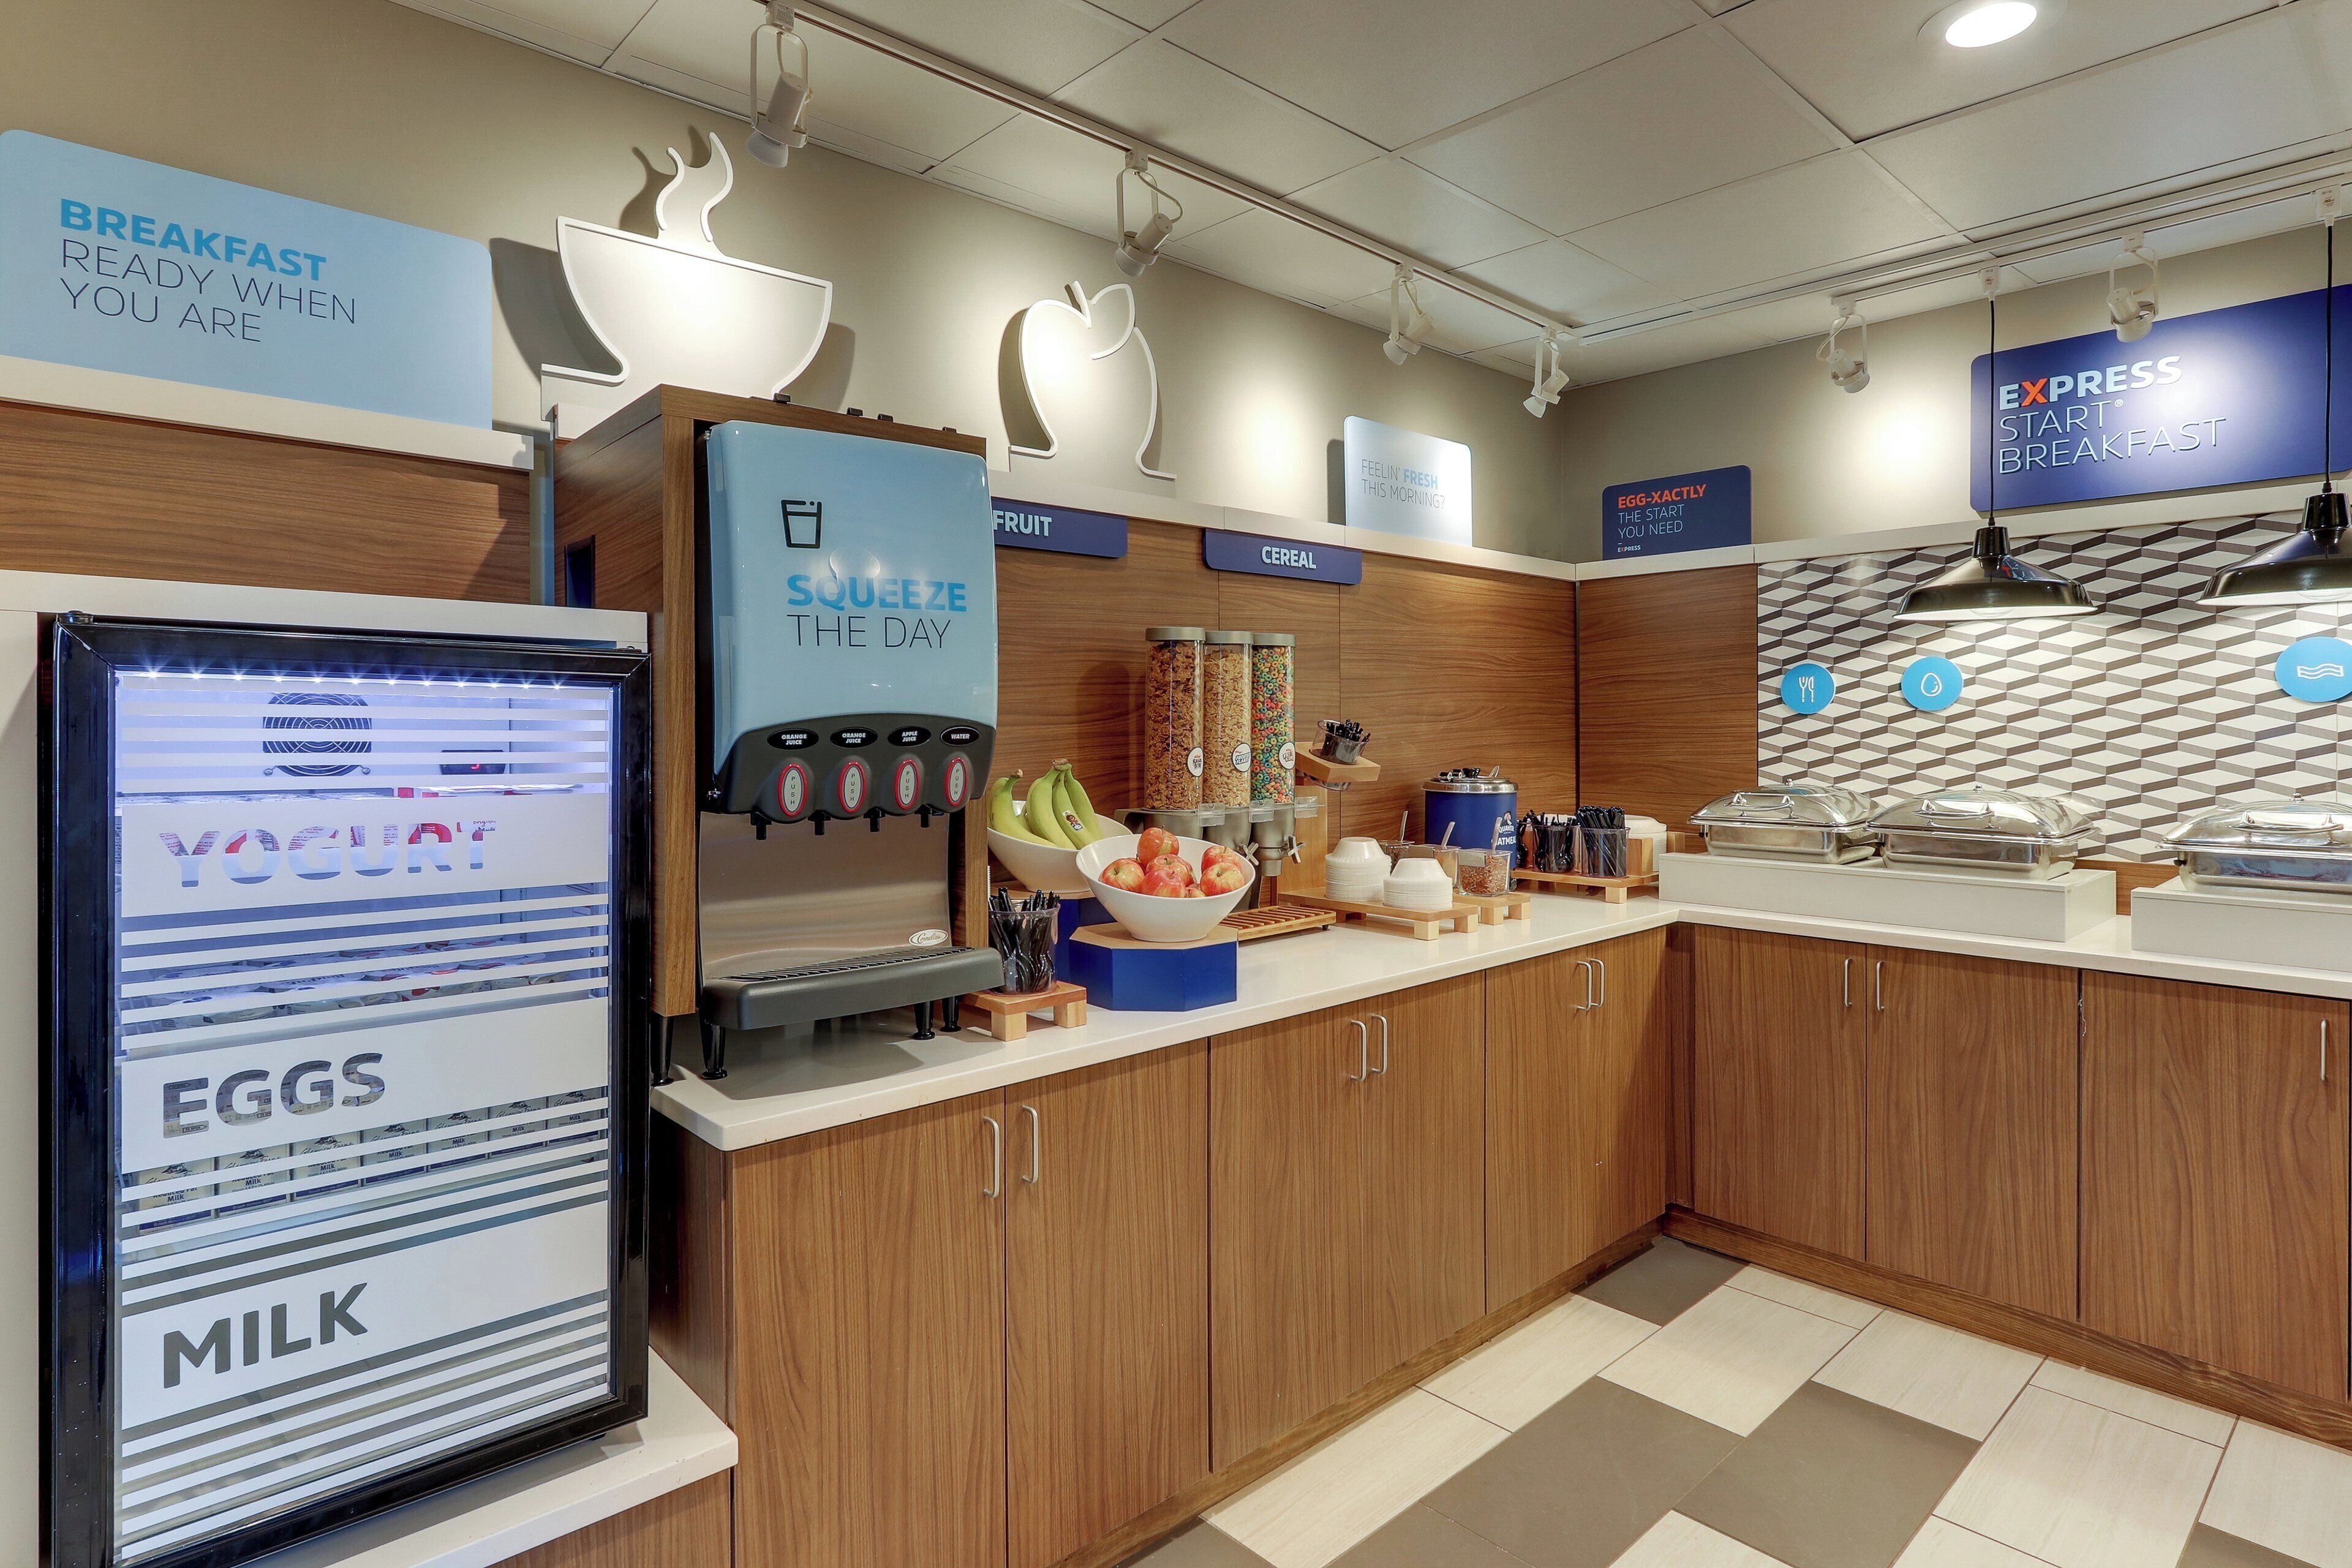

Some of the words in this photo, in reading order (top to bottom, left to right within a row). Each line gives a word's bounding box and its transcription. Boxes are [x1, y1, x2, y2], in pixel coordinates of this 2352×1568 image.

[60, 198, 326, 281] BREAKFAST
[62, 238, 215, 295] READY
[232, 273, 356, 325] WHEN
[60, 277, 159, 323] YOU
[178, 302, 261, 343] ARE
[1999, 355, 2182, 410] EXPRESS
[1999, 416, 2226, 473] BREAKFAST
[1362, 459, 1400, 481] FEELIN'
[1403, 469, 1438, 489] FRESH
[1362, 478, 1386, 498] THIS
[1390, 484, 1446, 510] MORNING?
[1618, 484, 1707, 509] EGG-XACTLY
[992, 510, 1052, 537] FRUIT
[1618, 510, 1642, 524] THE
[1646, 504, 1685, 521] START
[1618, 525, 1645, 539] YOU
[1649, 520, 1683, 536] NEED
[1262, 546, 1317, 569] CEREAL
[786, 574, 968, 612] SQUEEZE
[786, 614, 867, 647] THE
[884, 616, 951, 649] DAY
[1498, 825, 1515, 834] QUAKER
[158, 818, 497, 889] YOGURT
[163, 1052, 385, 1139] EGGS
[167, 1194, 184, 1202] Milk
[245, 1178, 262, 1186] Milk
[163, 1283, 369, 1389] MILK
